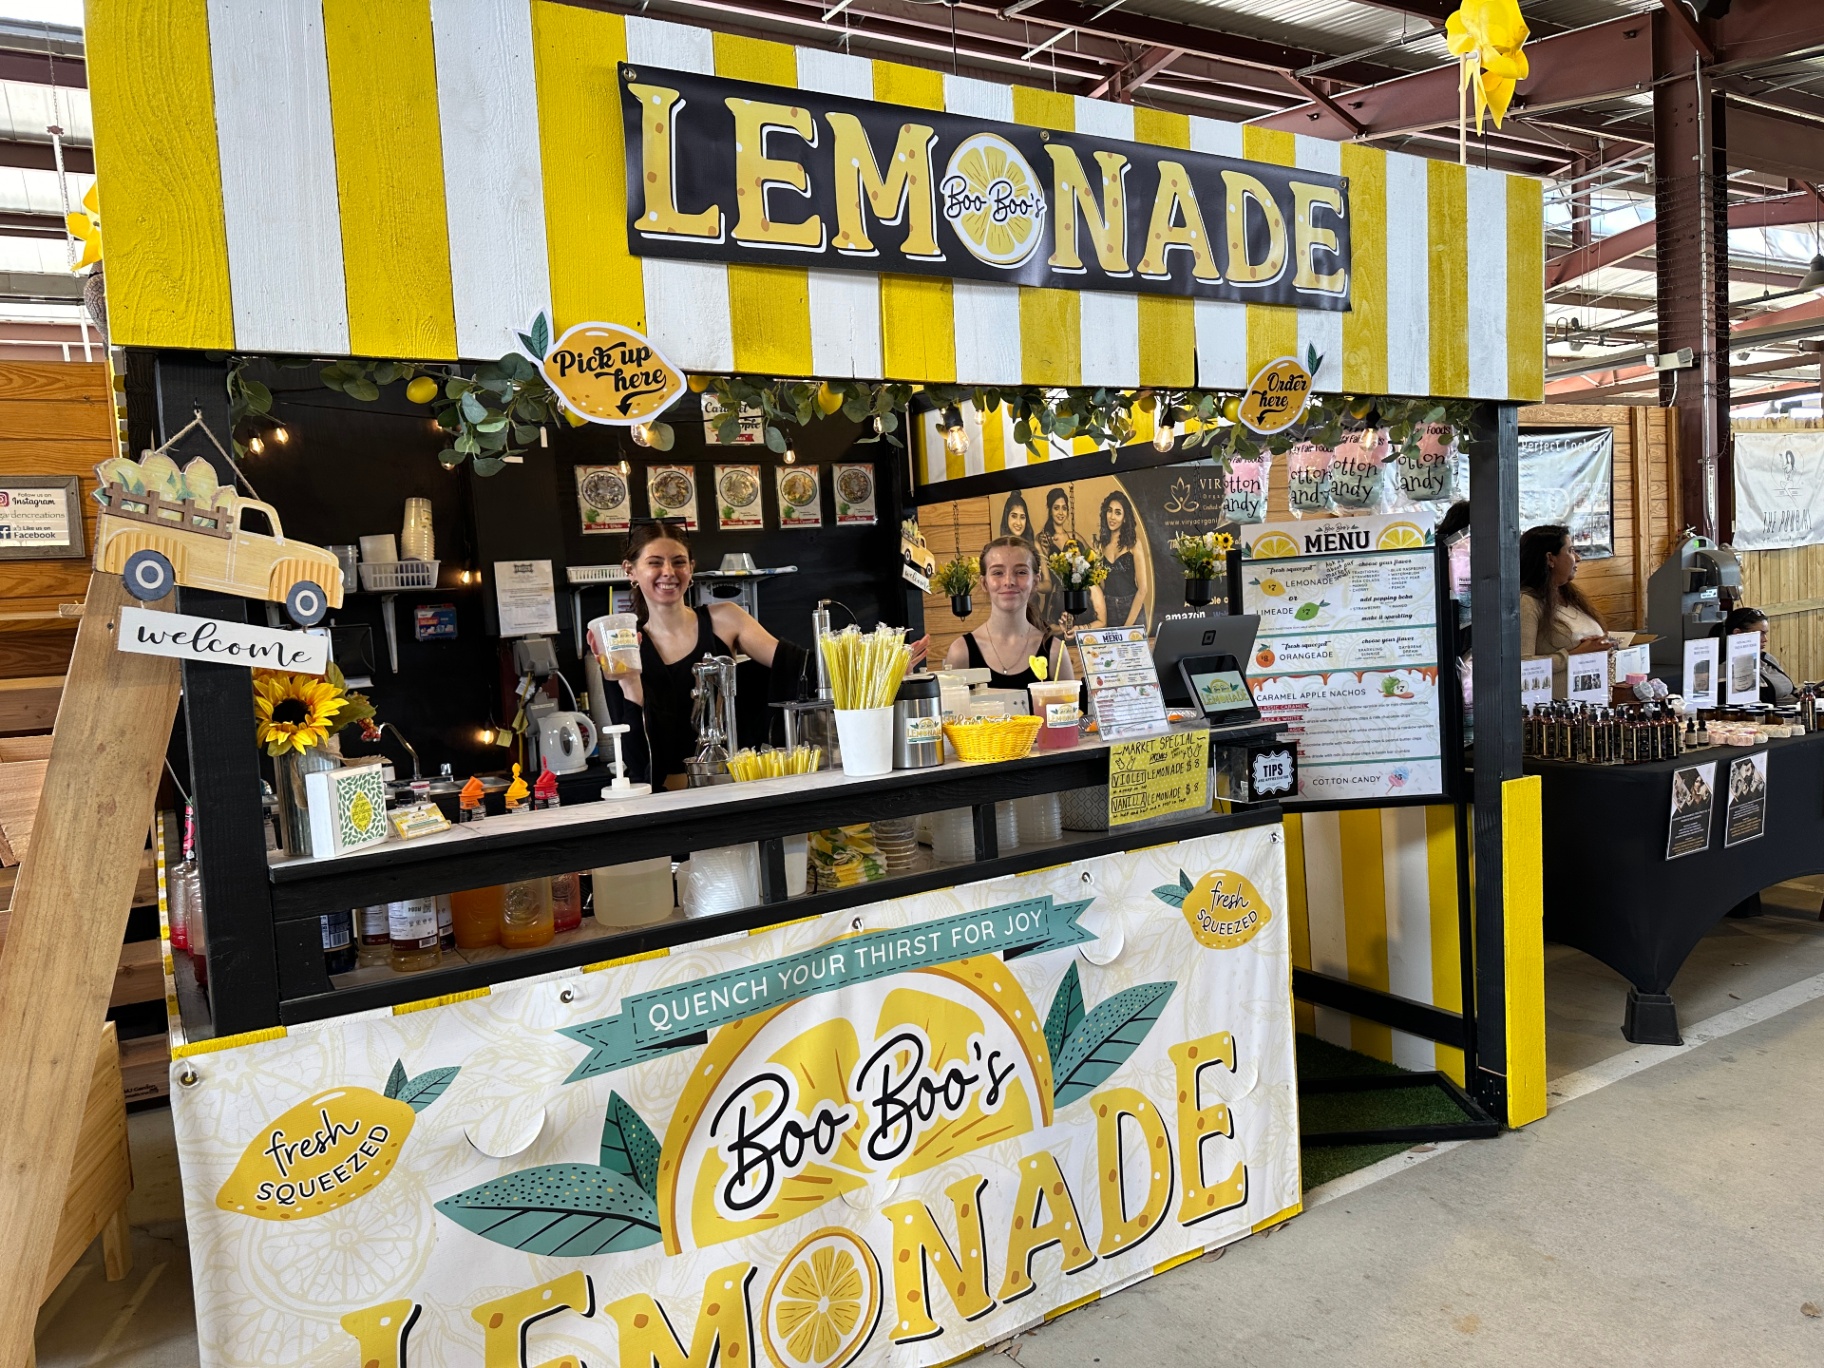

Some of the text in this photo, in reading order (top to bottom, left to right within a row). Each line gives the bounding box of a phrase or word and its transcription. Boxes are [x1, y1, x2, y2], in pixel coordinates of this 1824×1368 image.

[628, 82, 1348, 297] LEMONADE
[942, 175, 1045, 222] Boo Boo's
[553, 341, 653, 377] Pick up
[594, 368, 666, 392] here
[1267, 372, 1308, 392] Order
[1252, 390, 1288, 408] here
[1291, 466, 1332, 484] otton
[1334, 457, 1378, 478] otton
[1200, 478, 1222, 490] VIR
[1224, 476, 1260, 494] otton
[1331, 475, 1374, 504] andy
[1400, 466, 1444, 496] andy
[12, 496, 56, 508] Instagram
[1224, 491, 1260, 518] andy
[1290, 482, 1330, 506] andy
[1304, 531, 1371, 554] MENU
[1286, 578, 1334, 588] LEMONADE
[1256, 608, 1294, 616] LIMEADE
[137, 622, 312, 667] welcome
[1279, 651, 1334, 661] ORANGEADE
[1256, 689, 1366, 702] CARAMEL APPLE NACHOS
[1122, 740, 1156, 755] MARKET
[1160, 732, 1195, 750] SPECIAL
[1112, 772, 1144, 787] VIOLET
[1147, 762, 1184, 780] LEMONADE
[1263, 764, 1283, 777] TIPS
[1112, 793, 1146, 812] VANILLA
[1147, 787, 1181, 805] LEMONADE
[1210, 882, 1250, 910] fresh
[1197, 910, 1259, 936] SQUEEZED
[648, 906, 1044, 1031] QUENCH YOUR THIRST FOR JOY
[710, 1031, 1015, 1211] Boo Boo's
[264, 1109, 361, 1179] fresh
[255, 1124, 390, 1206] SQUEEZED
